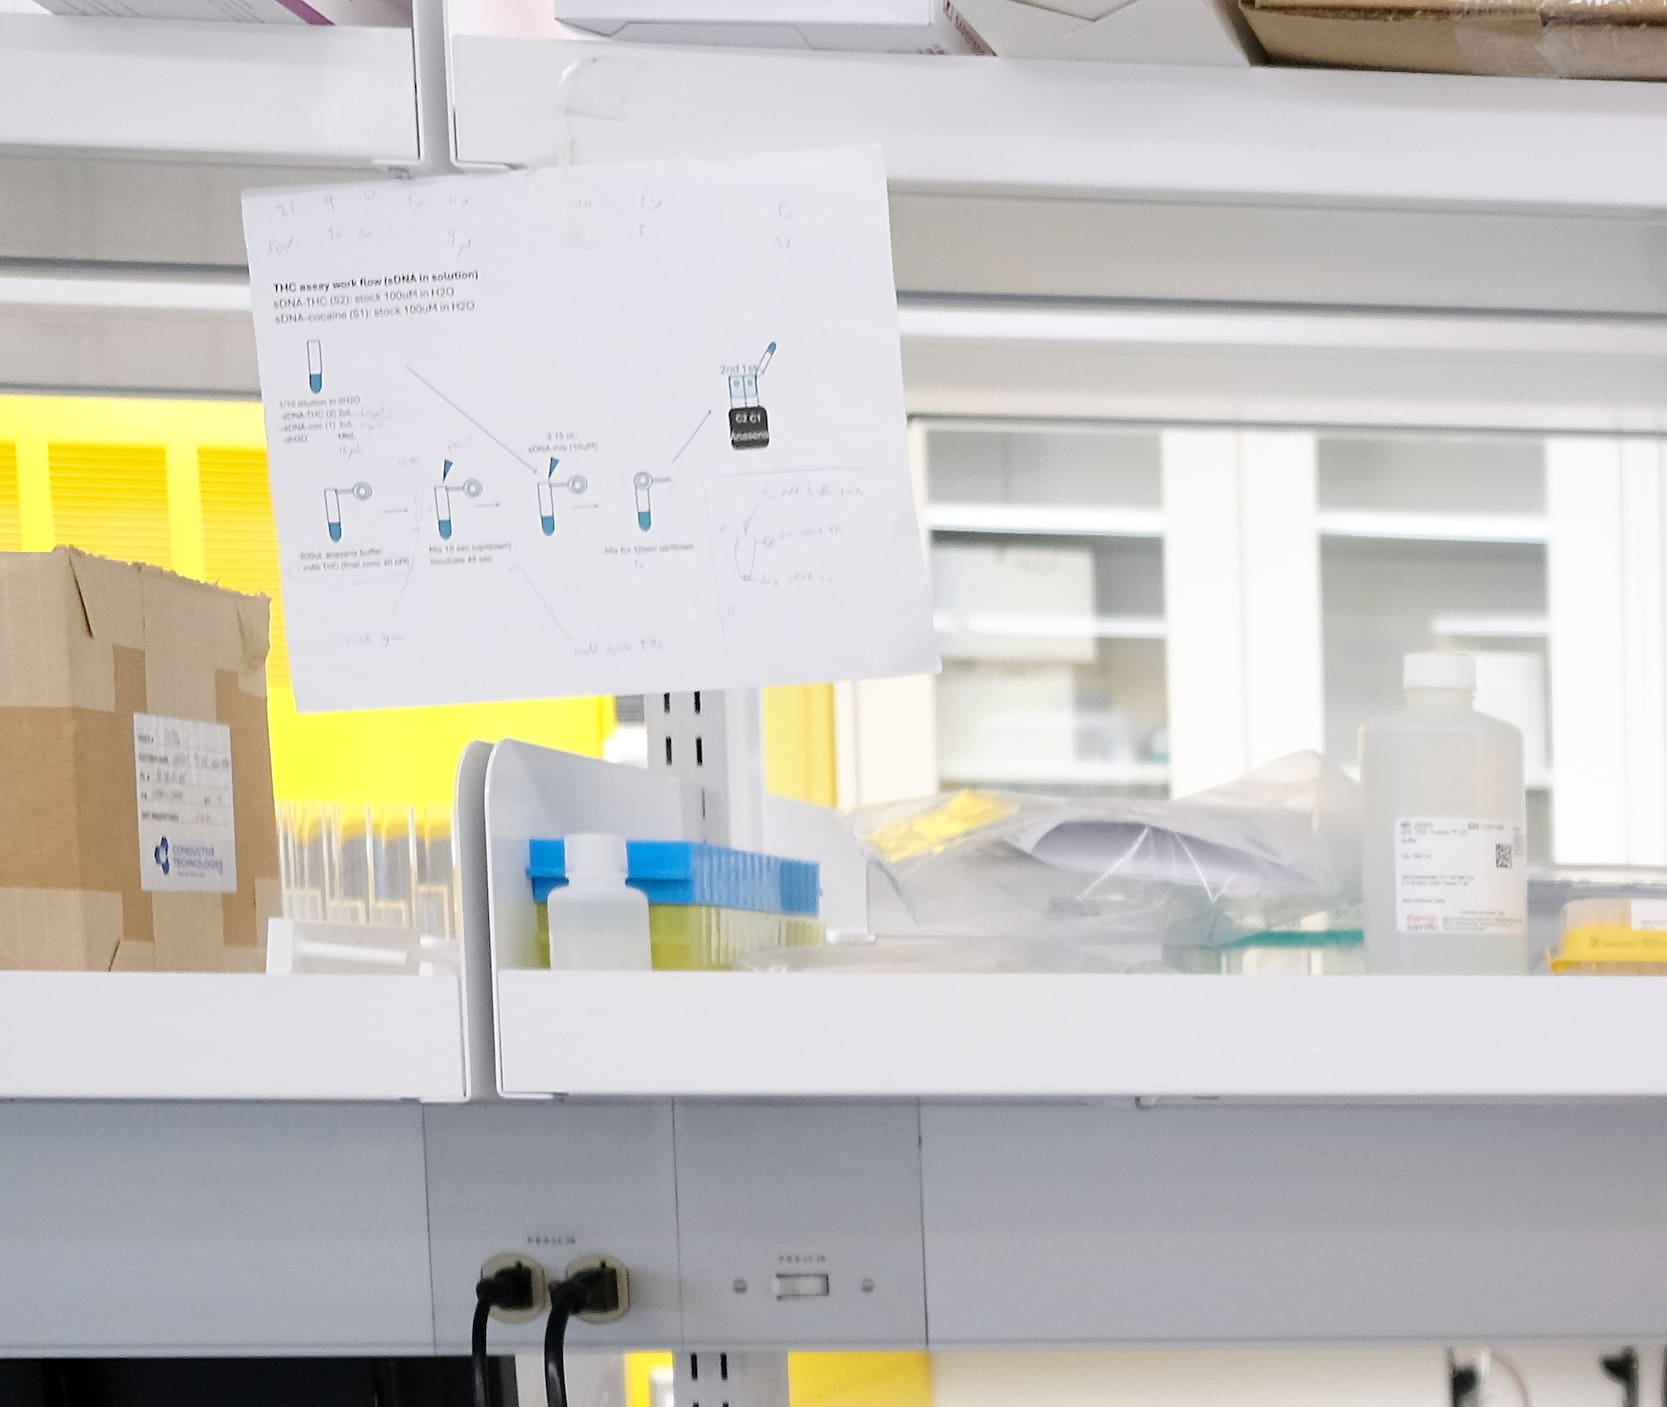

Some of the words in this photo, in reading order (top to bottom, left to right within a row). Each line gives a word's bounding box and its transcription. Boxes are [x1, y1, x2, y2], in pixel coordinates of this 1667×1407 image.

[274, 283, 296, 293] THC
[299, 282, 330, 293] assay
[333, 279, 357, 290] work
[360, 277, 381, 288] flow
[384, 275, 416, 287] (sDNA
[419, 274, 429, 282] in
[432, 270, 479, 282] solution)
[354, 292, 381, 304] stock
[385, 289, 418, 301] 100uM
[420, 289, 430, 297] in
[431, 287, 455, 297] H2O
[275, 310, 347, 325] sDNA-cocaine
[374, 307, 401, 318] stock
[404, 304, 438, 316] 100uM
[440, 303, 450, 312] in
[451, 301, 475, 312] H2O
[719, 365, 740, 375] 2nd
